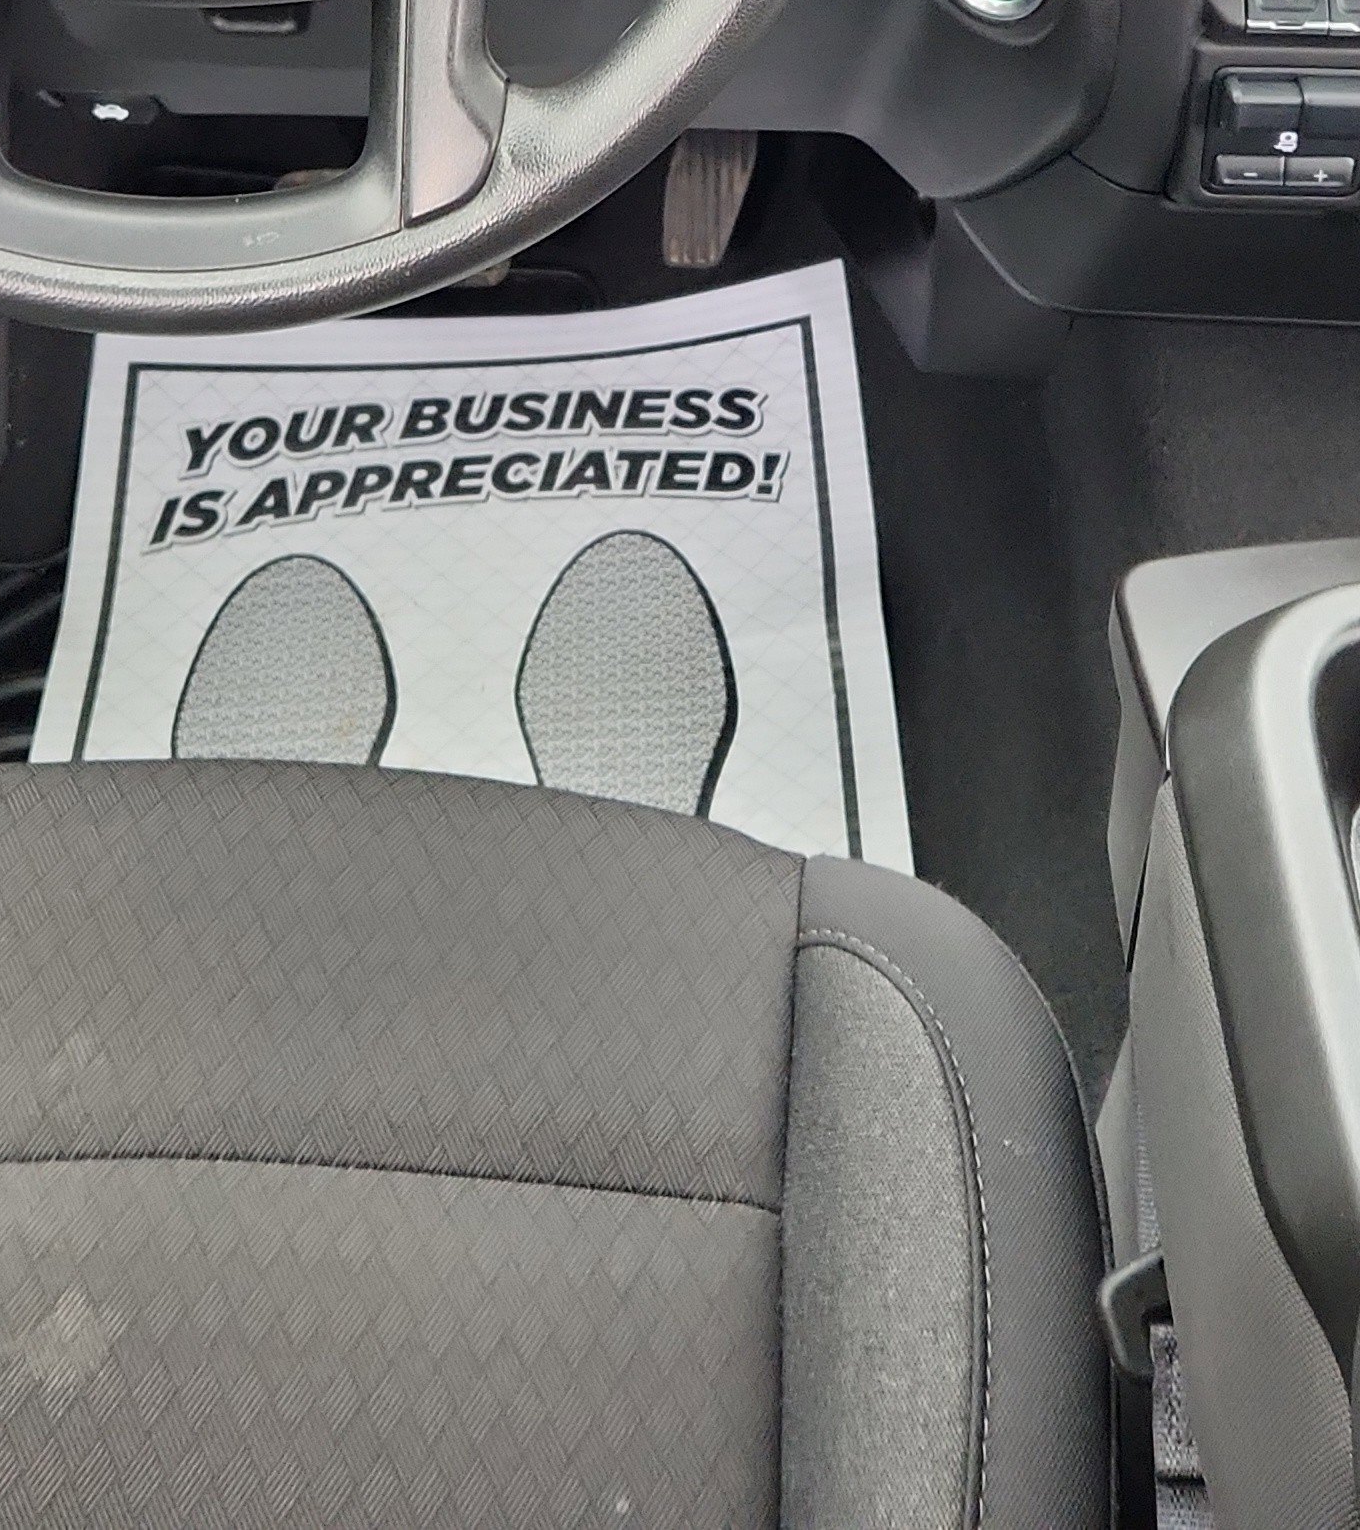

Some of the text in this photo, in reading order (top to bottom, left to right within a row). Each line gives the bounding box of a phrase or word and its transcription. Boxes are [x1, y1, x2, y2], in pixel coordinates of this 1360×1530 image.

[182, 387, 764, 472] YOUR BUSINESS
[148, 449, 783, 546] IS APPRECIATED!
